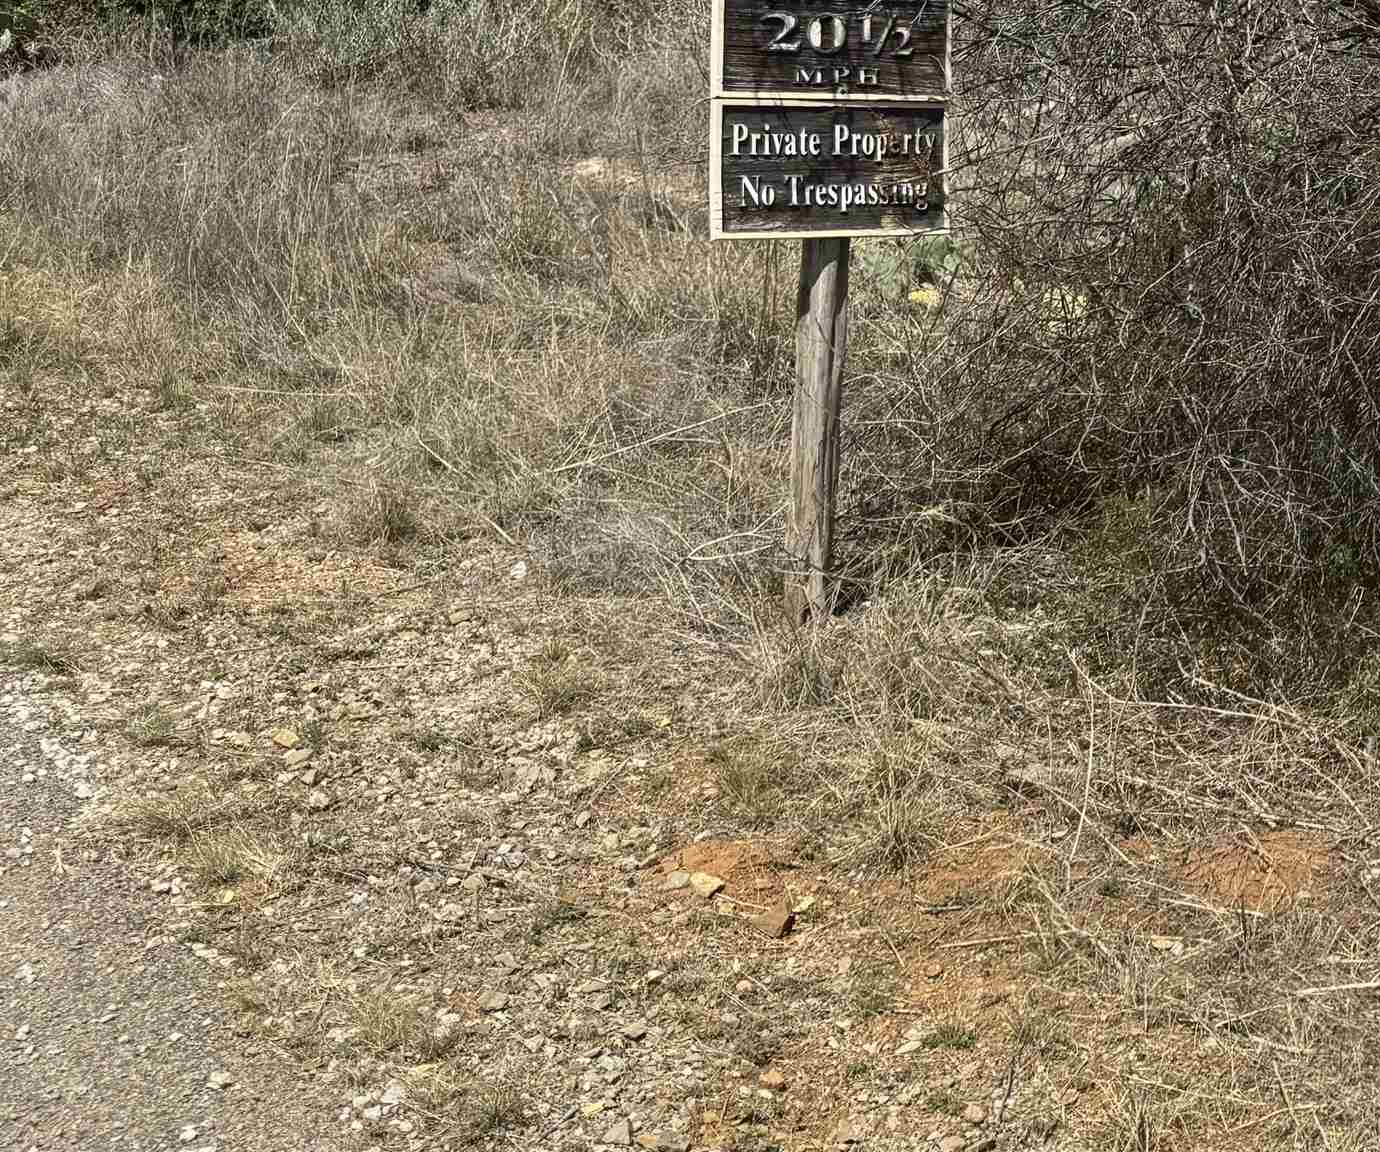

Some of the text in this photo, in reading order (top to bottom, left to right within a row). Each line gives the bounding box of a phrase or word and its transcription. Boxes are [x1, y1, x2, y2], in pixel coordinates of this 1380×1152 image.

[730, 123, 820, 156] Private
[739, 175, 929, 212] No Trespassing
